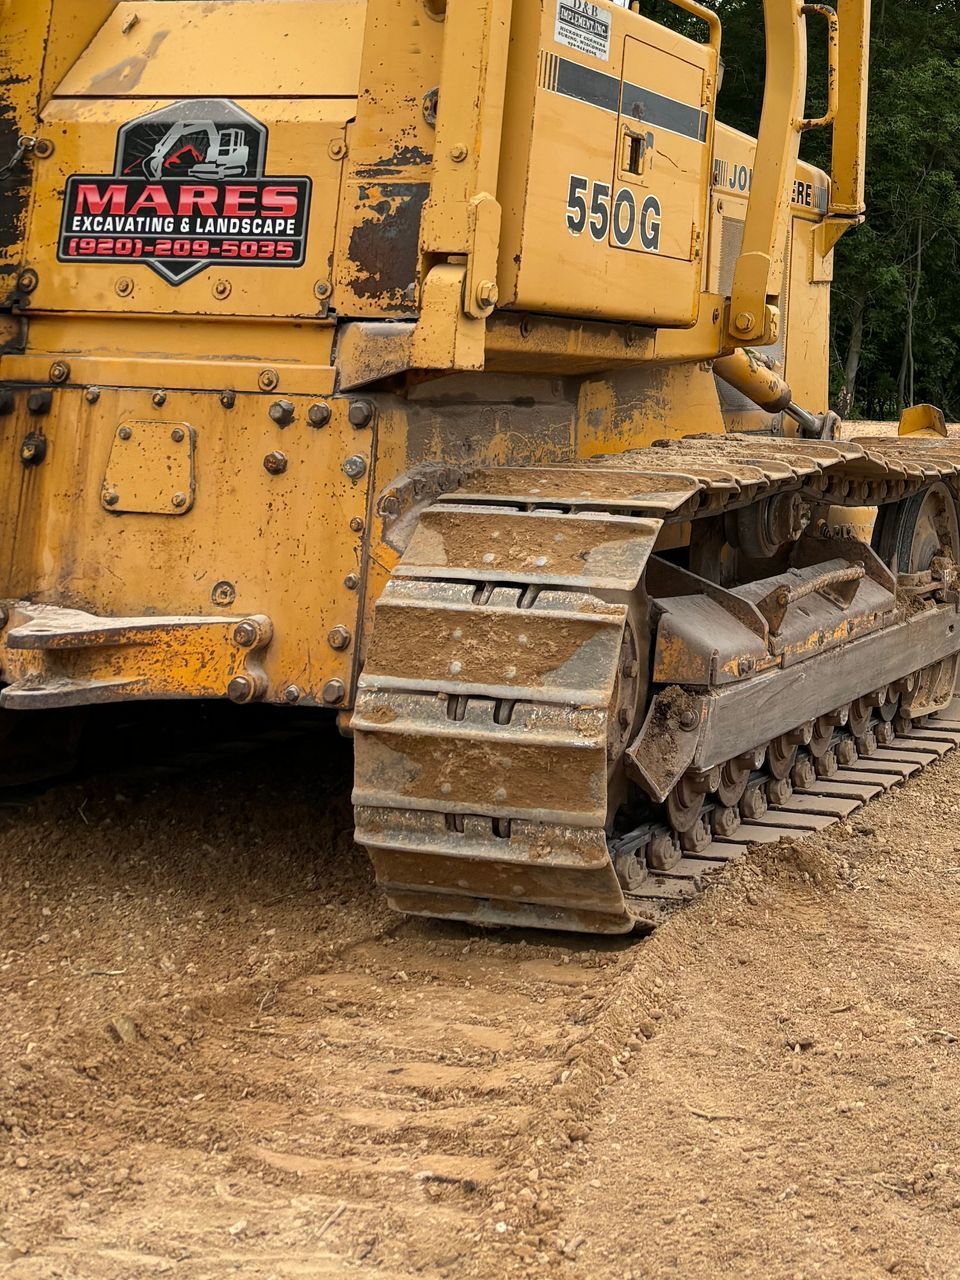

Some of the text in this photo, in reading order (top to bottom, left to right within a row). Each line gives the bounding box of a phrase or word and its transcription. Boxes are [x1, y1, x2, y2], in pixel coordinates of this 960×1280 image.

[729, 164, 753, 193] JO
[74, 183, 299, 218] MARES
[566, 174, 661, 252] 550G
[72, 216, 296, 235] EXCAVATING & LANDSCAPE
[68, 237, 294, 258] (920)-209-5035
